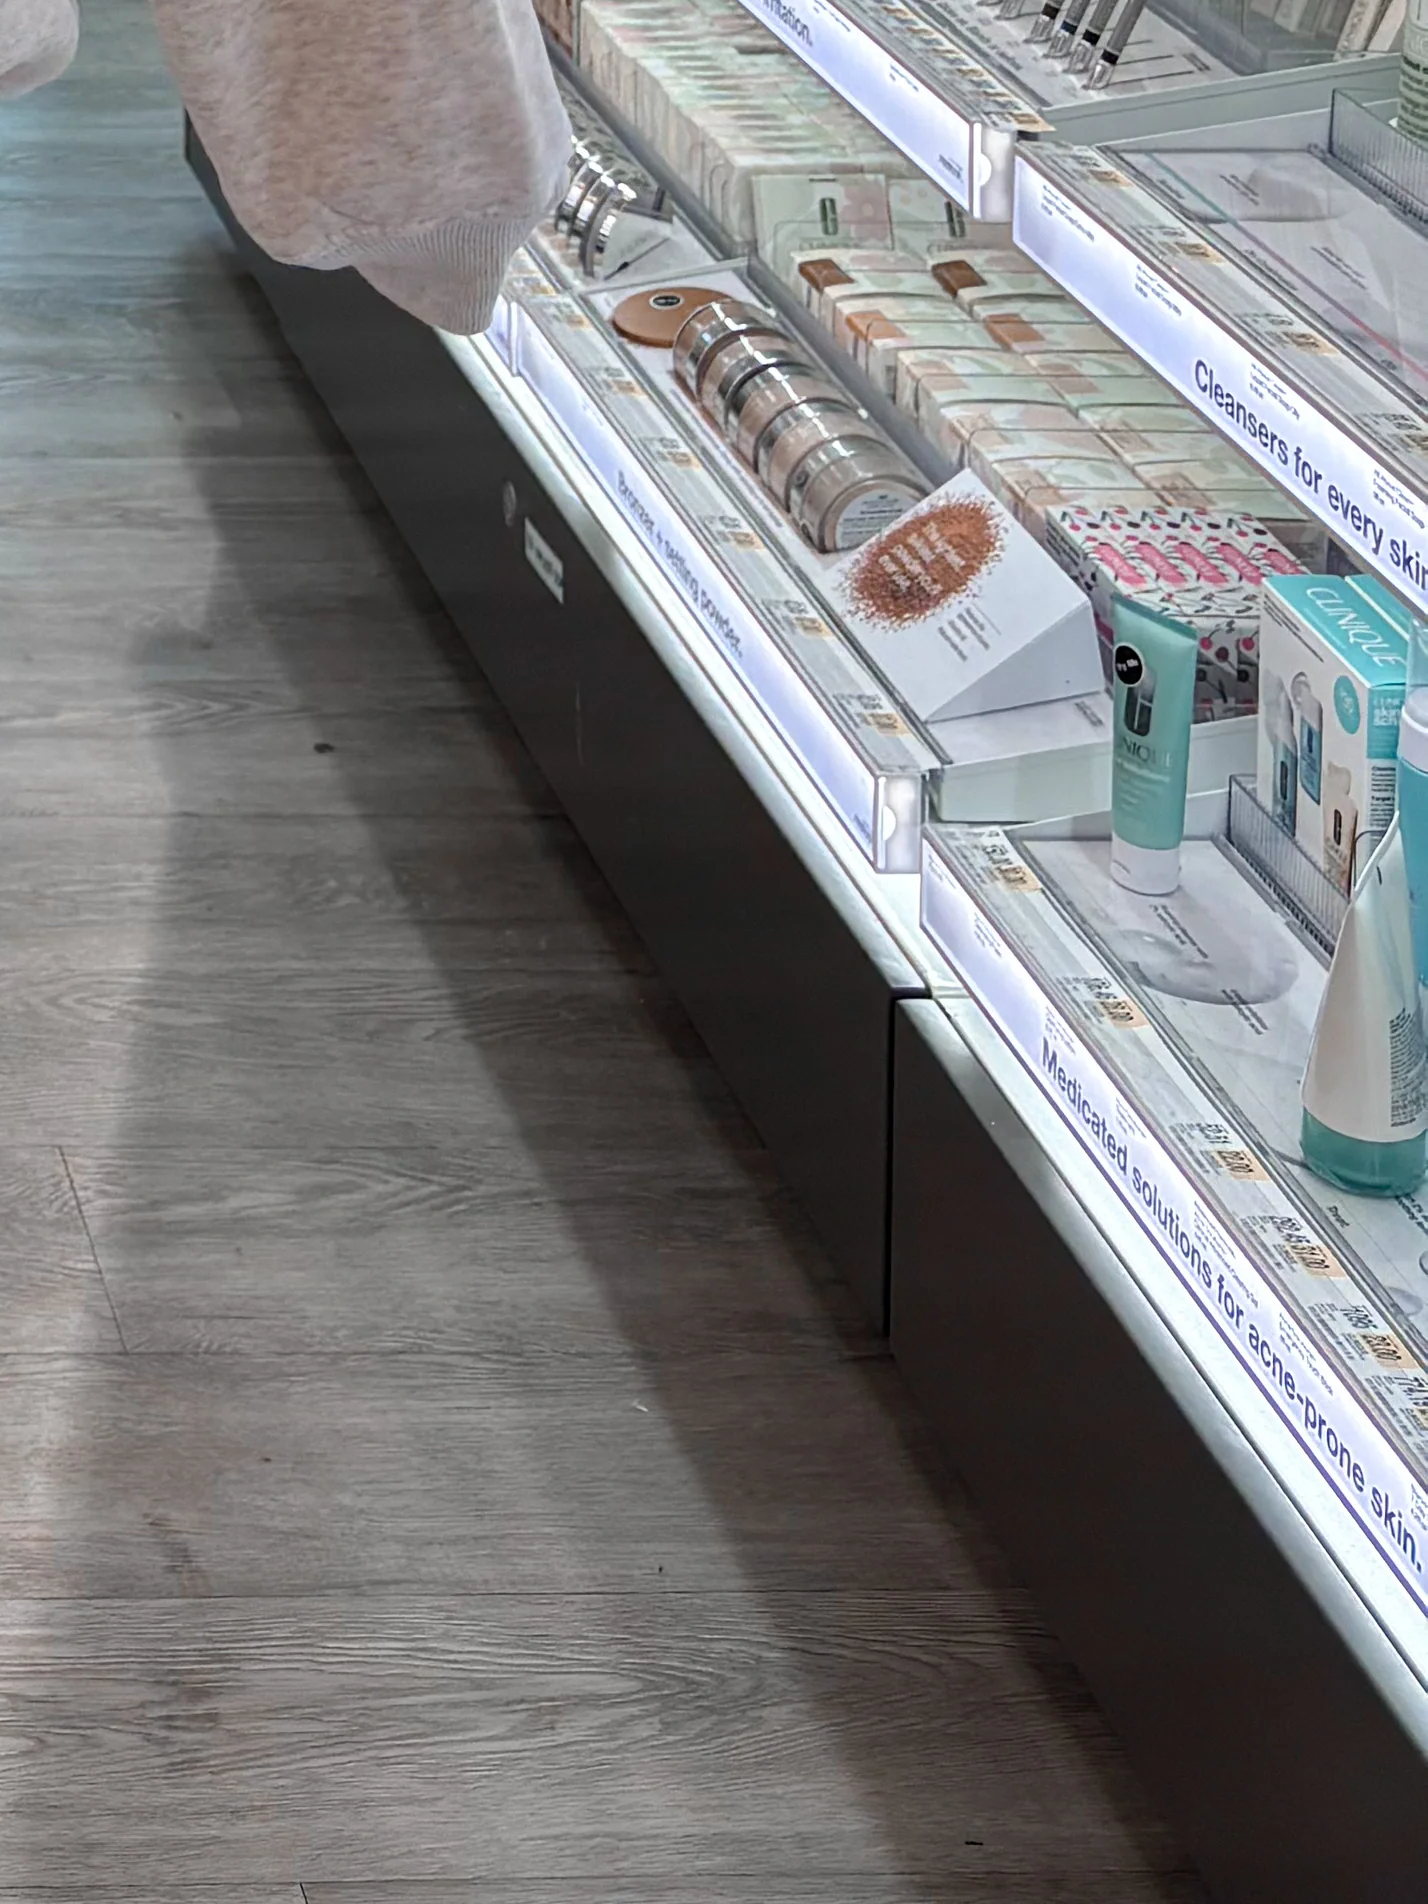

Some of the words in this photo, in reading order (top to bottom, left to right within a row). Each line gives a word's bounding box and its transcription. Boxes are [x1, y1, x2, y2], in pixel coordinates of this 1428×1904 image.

[1194, 358, 1290, 466] Cleansers
[1294, 445, 1324, 495] for
[1327, 483, 1385, 556] every
[1305, 586, 1407, 670] CLINIQUE
[1043, 1035, 1128, 1176] Medicated
[1132, 1165, 1212, 1289] solutions
[1216, 1274, 1245, 1329] for
[1248, 1323, 1365, 1493] acne-prone
[1370, 1484, 1422, 1573] skin.
